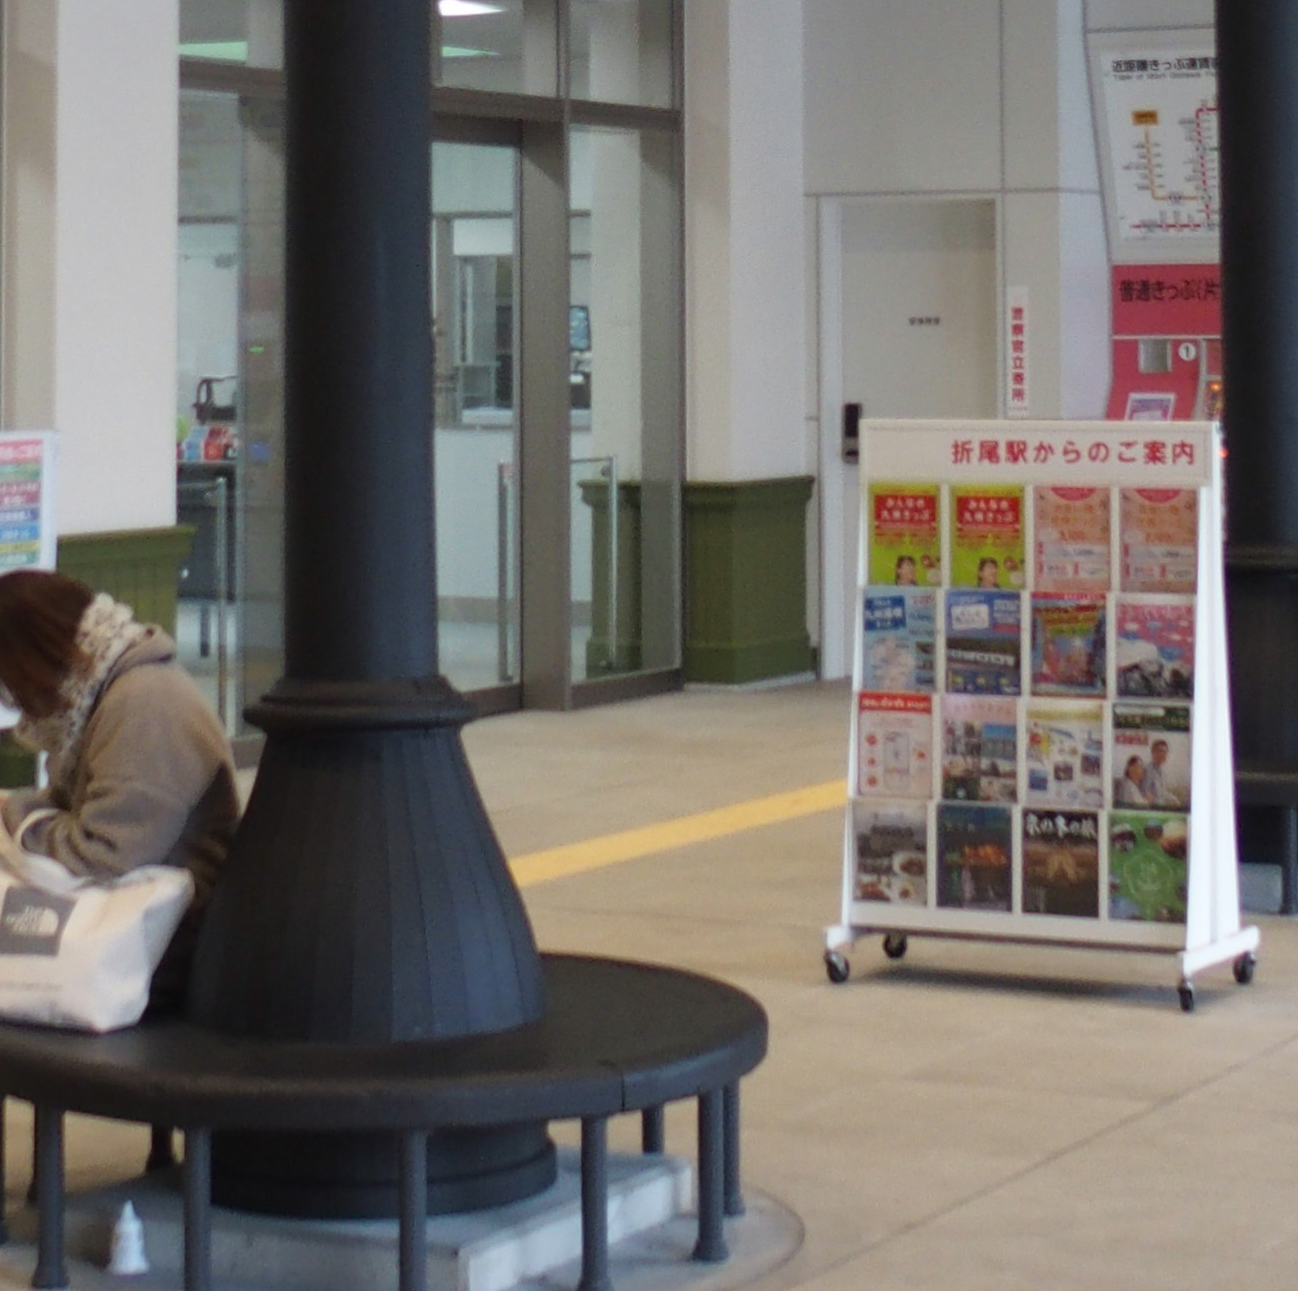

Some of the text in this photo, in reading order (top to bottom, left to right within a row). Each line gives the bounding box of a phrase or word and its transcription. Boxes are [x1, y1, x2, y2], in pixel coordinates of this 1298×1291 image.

[951, 439, 1196, 466] 折尾駅からのご案内
